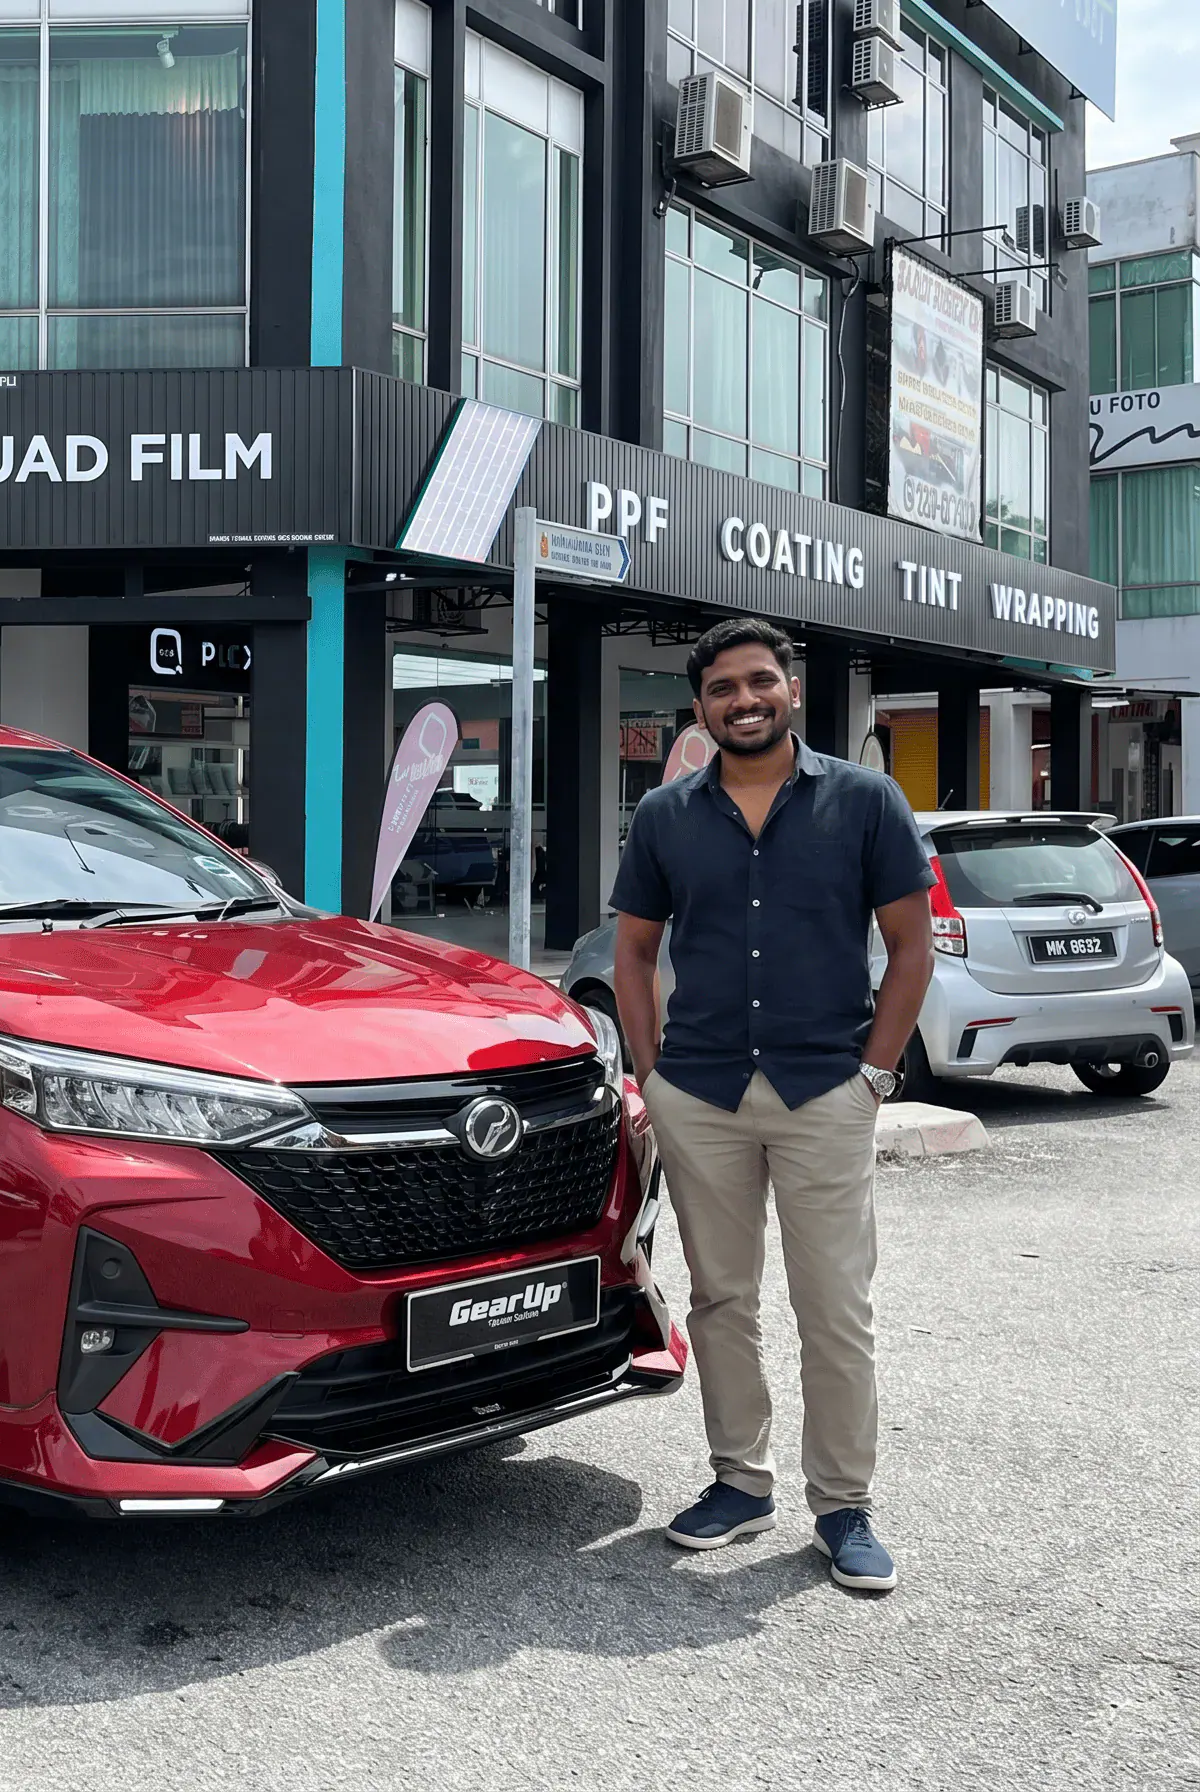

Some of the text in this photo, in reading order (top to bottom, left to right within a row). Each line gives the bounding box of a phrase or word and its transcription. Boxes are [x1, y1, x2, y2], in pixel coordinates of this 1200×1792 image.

[1109, 391, 1161, 413] FOTO
[130, 432, 272, 481] FILM
[587, 481, 1099, 639] PPF COATING TINT WRAPPING
